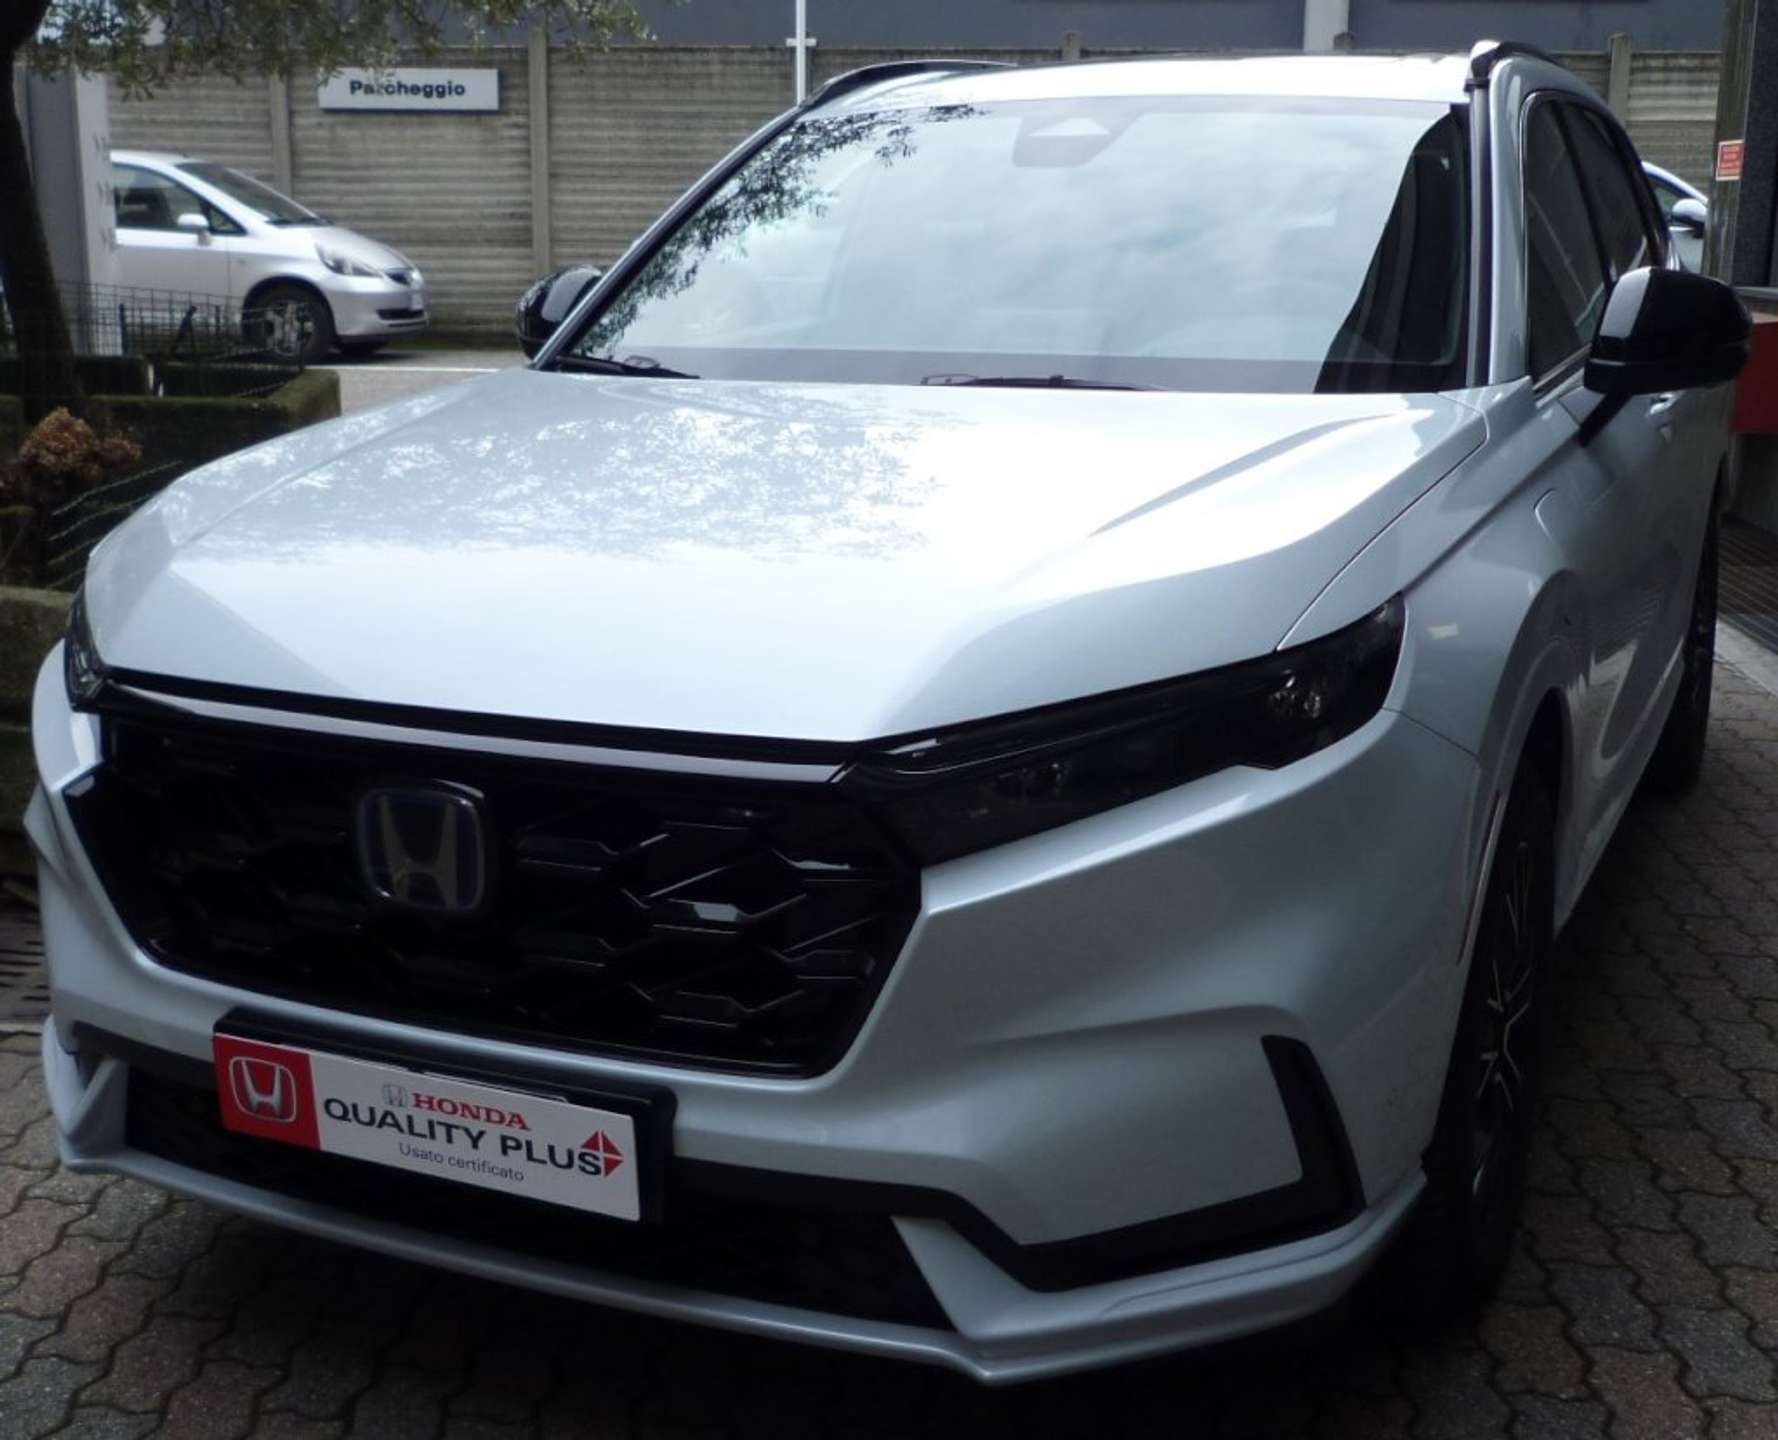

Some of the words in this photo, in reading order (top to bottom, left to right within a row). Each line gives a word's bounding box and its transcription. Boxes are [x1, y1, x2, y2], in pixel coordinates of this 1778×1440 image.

[413, 1092, 530, 1130] HONDA
[323, 1097, 487, 1150] QUALITY
[500, 1133, 602, 1177] PLUS
[398, 1142, 444, 1164] Usato
[447, 1154, 525, 1181] certificato
